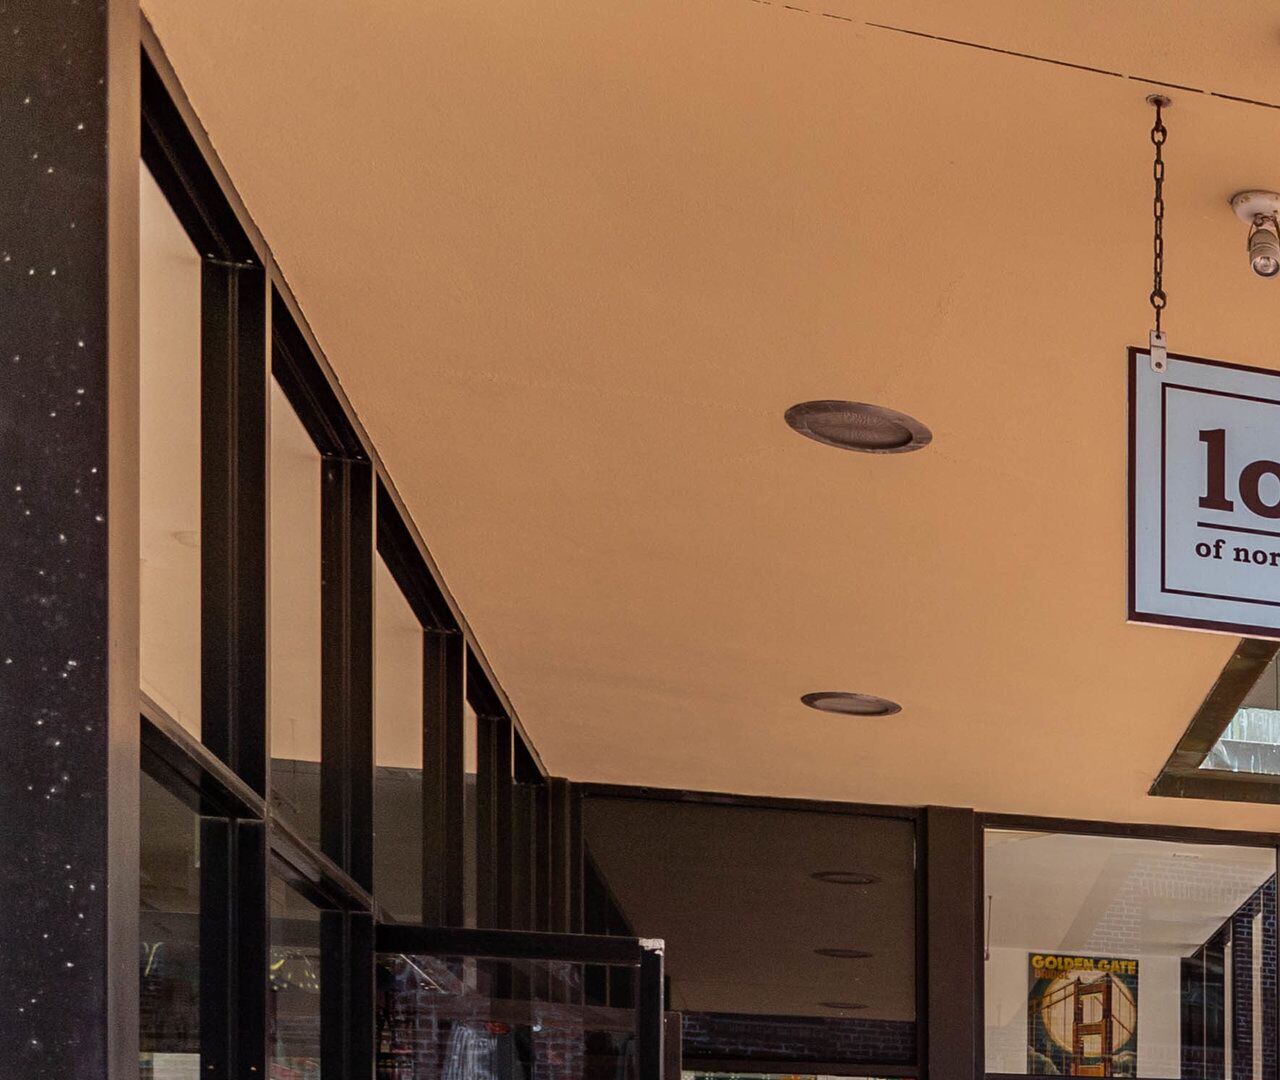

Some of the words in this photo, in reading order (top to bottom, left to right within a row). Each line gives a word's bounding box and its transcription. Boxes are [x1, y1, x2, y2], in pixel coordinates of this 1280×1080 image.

[1195, 539, 1226, 559] of
[1032, 955, 1094, 971] GOLDEN
[1098, 960, 1137, 974] GATE
